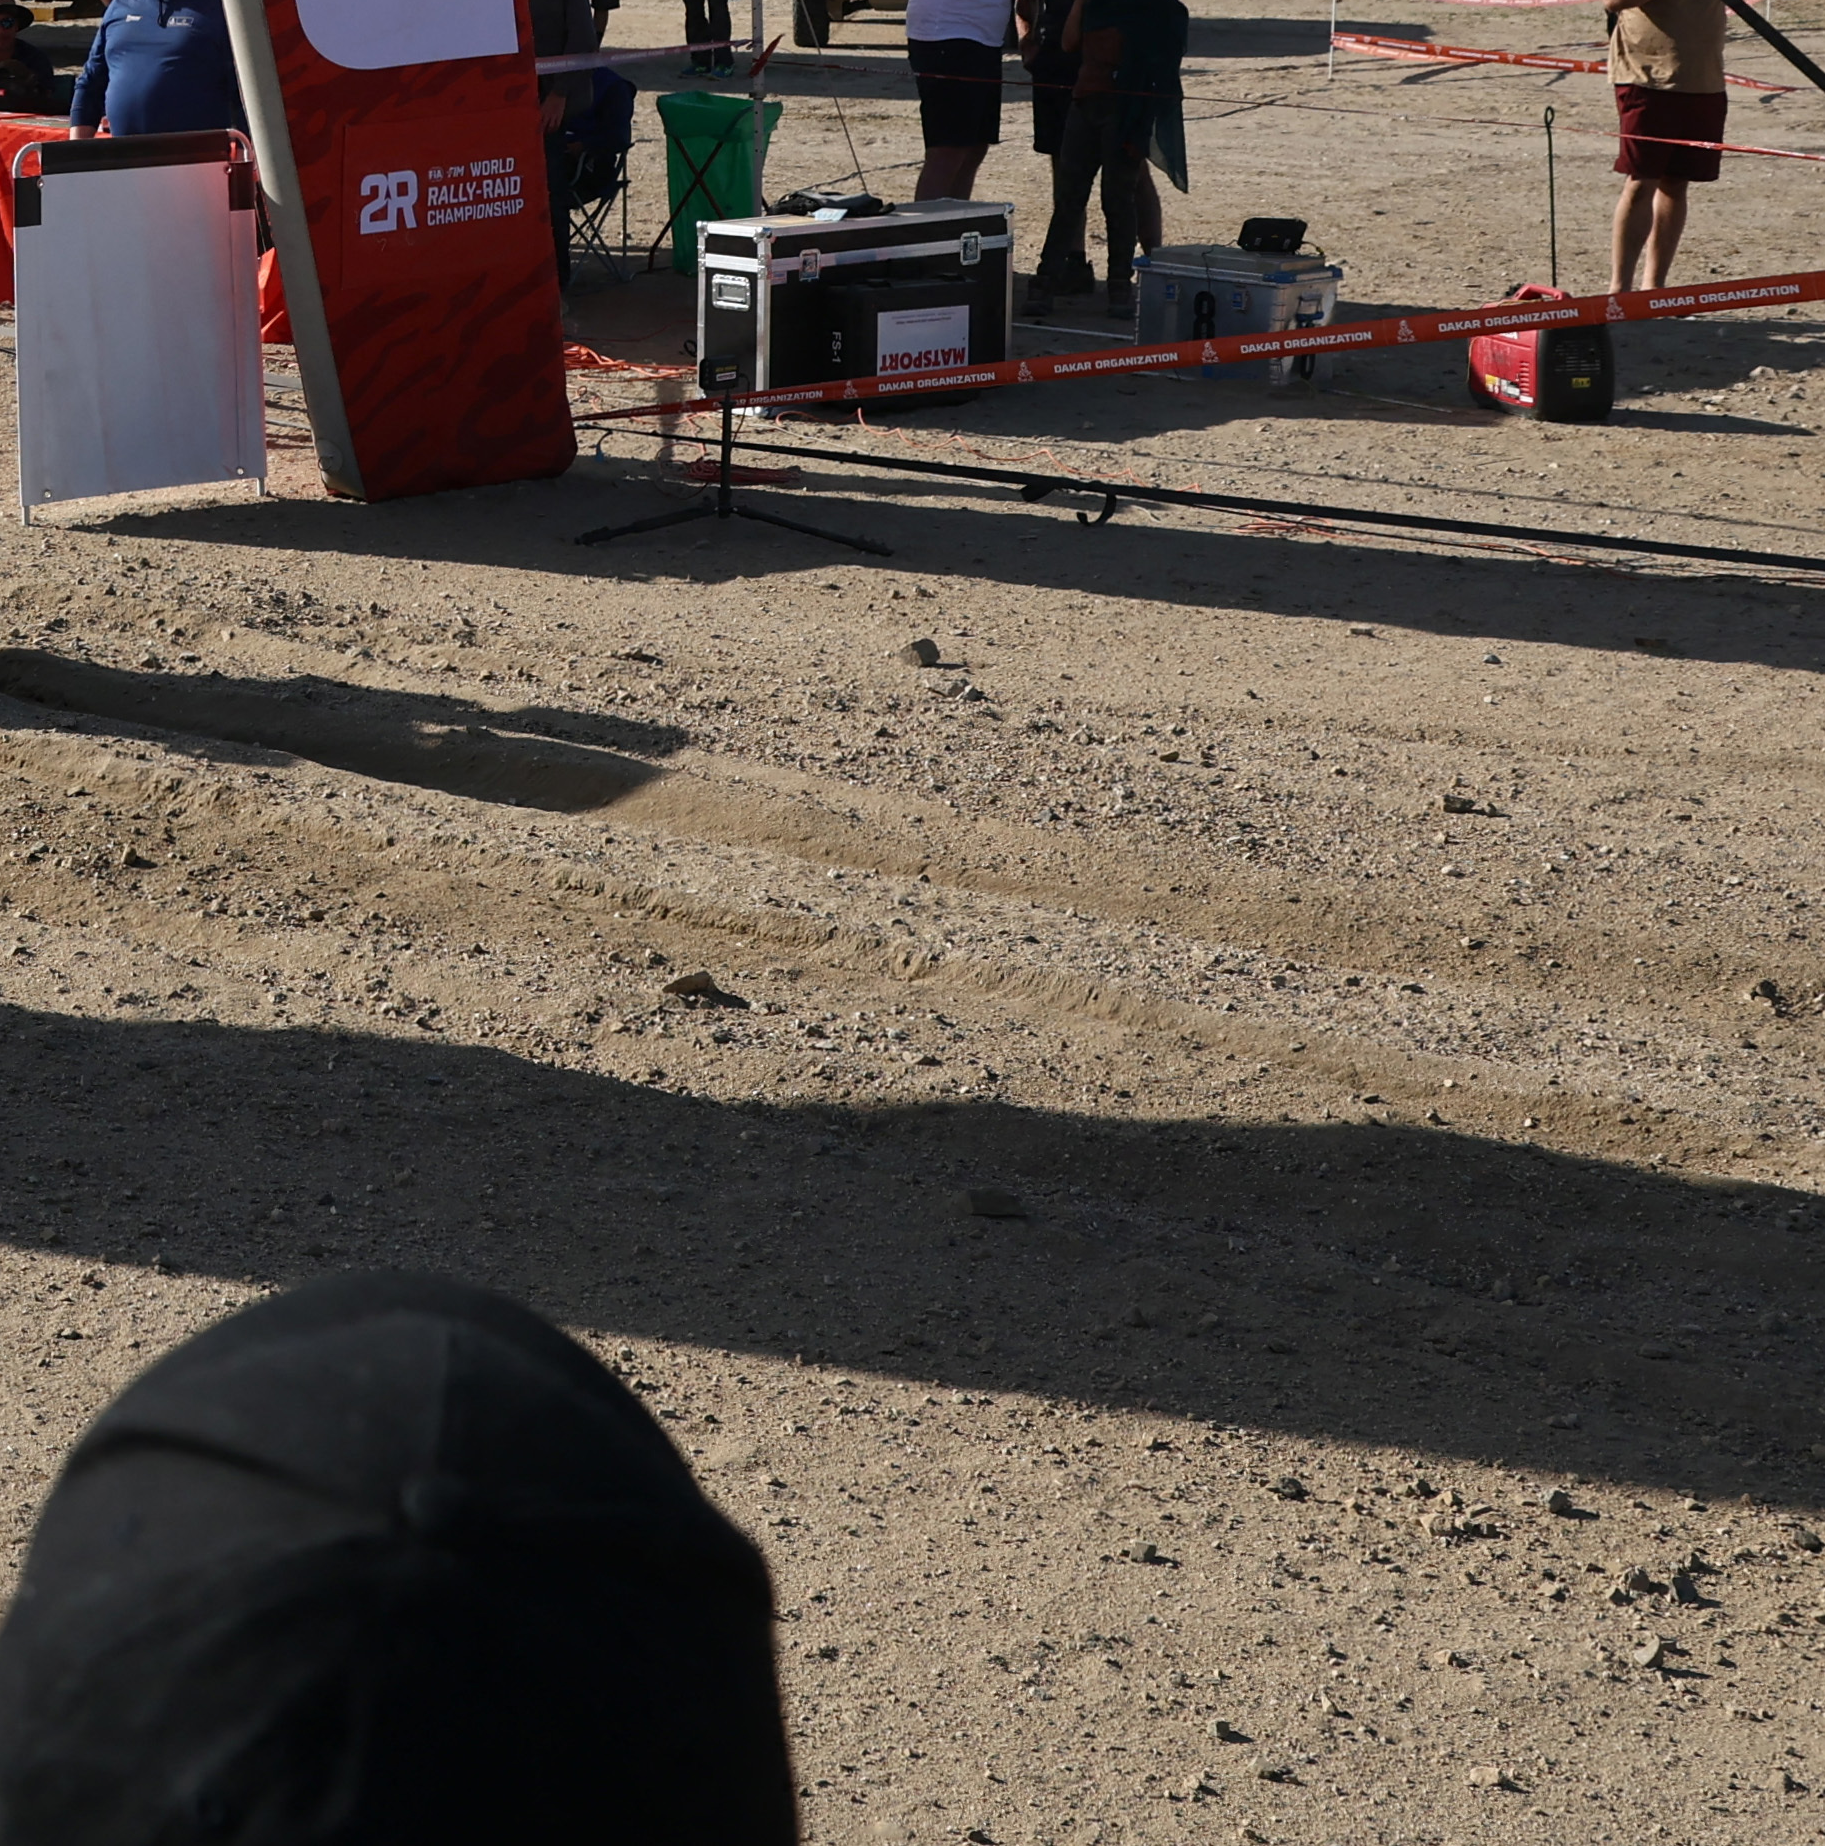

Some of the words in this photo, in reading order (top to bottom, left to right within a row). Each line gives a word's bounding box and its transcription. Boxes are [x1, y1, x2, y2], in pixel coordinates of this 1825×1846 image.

[470, 157, 515, 178] WORLD
[359, 169, 418, 235] 2R
[427, 176, 521, 207] RALLY-RAID
[427, 199, 525, 227] CHAMPIONSHIP
[1648, 293, 1696, 311] DAKAR
[1698, 283, 1801, 306] ORGANIZATION
[1437, 318, 1482, 333] DAKAR
[1484, 307, 1580, 328] ORGANIZATION
[832, 331, 842, 364] FS-1
[1240, 341, 1282, 354] DAKAR
[1284, 331, 1373, 350] ORGANIZATION
[879, 346, 966, 372] MATSPORT
[1053, 359, 1097, 375] DAKAR
[1100, 351, 1179, 371] ORGANIZATION
[877, 377, 915, 393] DAKAR
[917, 371, 997, 389] ORGANIZATION
